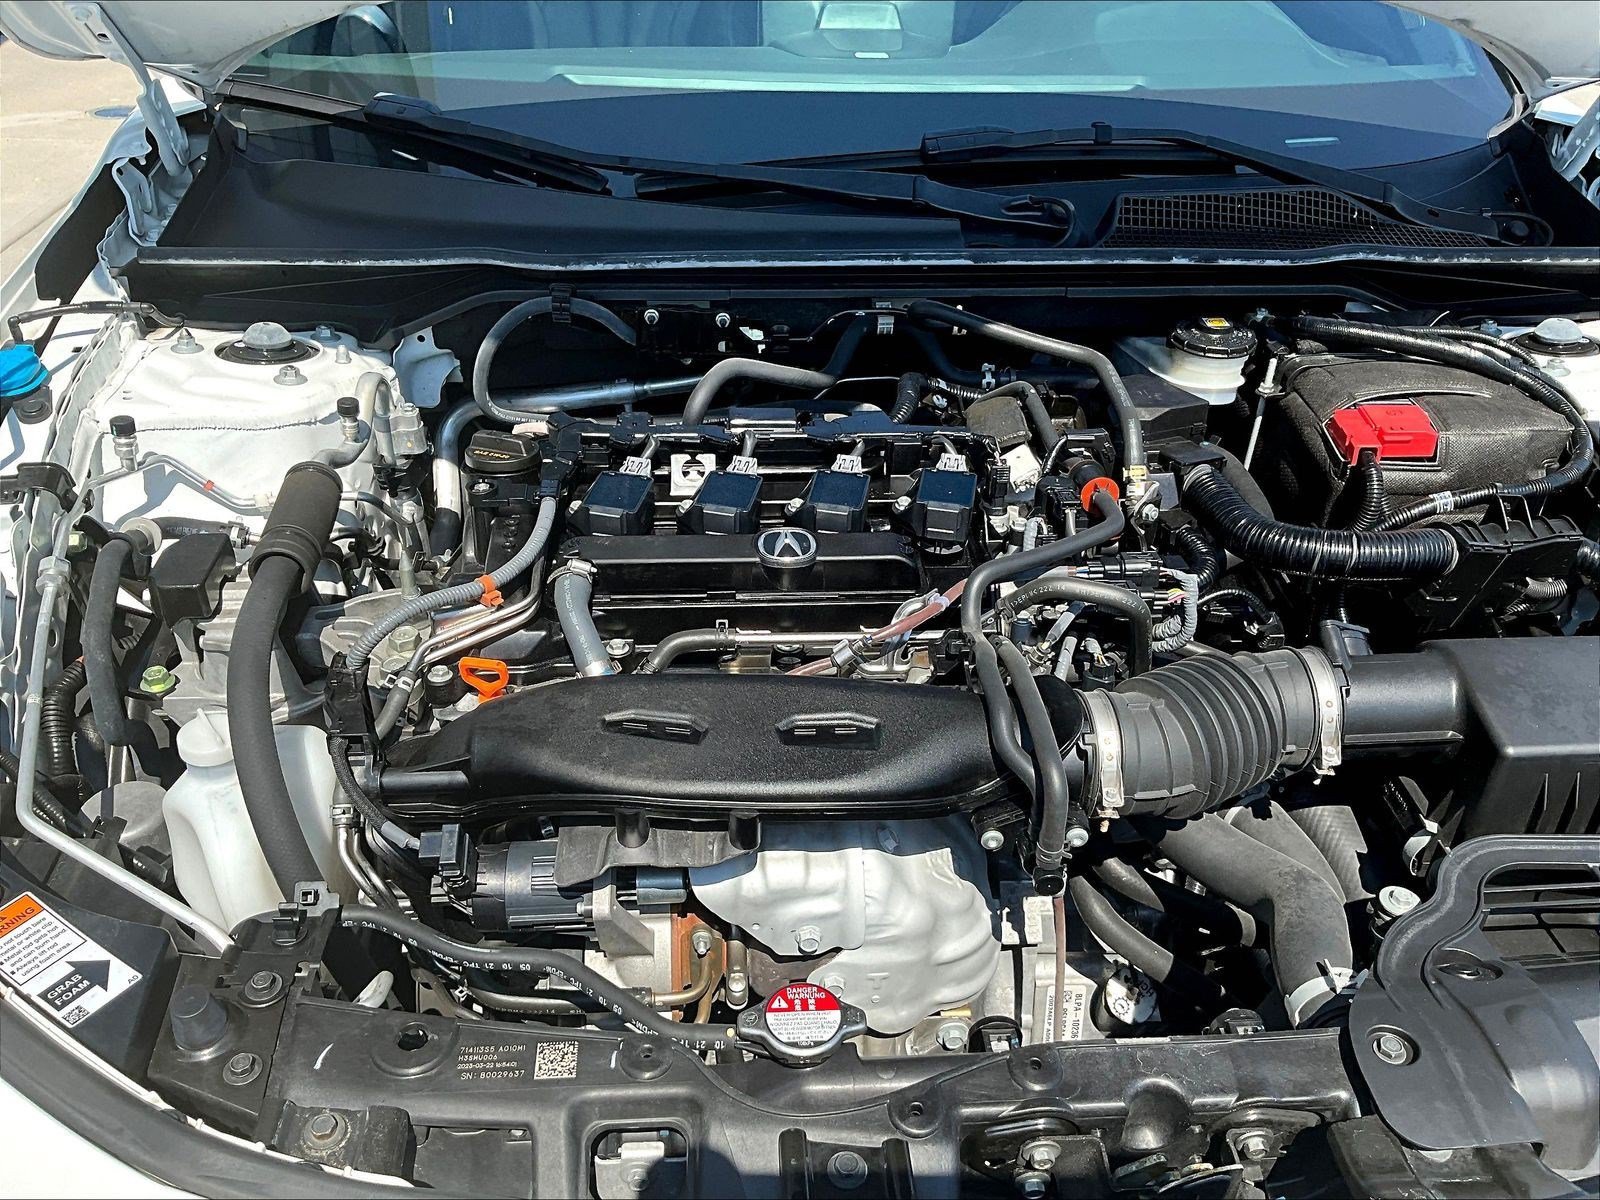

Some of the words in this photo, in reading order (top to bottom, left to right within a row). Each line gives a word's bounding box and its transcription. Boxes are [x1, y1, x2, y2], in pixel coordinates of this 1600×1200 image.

[0, 907, 35, 932] RNING
[14, 926, 32, 939] touch
[31, 917, 46, 928] bare
[4, 949, 22, 962] Metal
[22, 942, 34, 950] rod
[34, 933, 48, 944] gets
[47, 926, 58, 934] hot
[25, 929, 42, 940] white
[10, 958, 22, 967] and
[24, 950, 36, 958] can
[35, 940, 50, 950] burn
[16, 956, 38, 972] Always
[47, 942, 58, 950] rod
[22, 963, 40, 976] using
[39, 952, 56, 964] foam
[47, 974, 82, 1000] GRAB
[54, 980, 90, 1006] FOAM
[570, 978, 582, 990] TPC
[1071, 994, 1082, 1040] 8LPA-10236
[714, 1040, 724, 1048] 10
[460, 1072, 477, 1080] SN:
